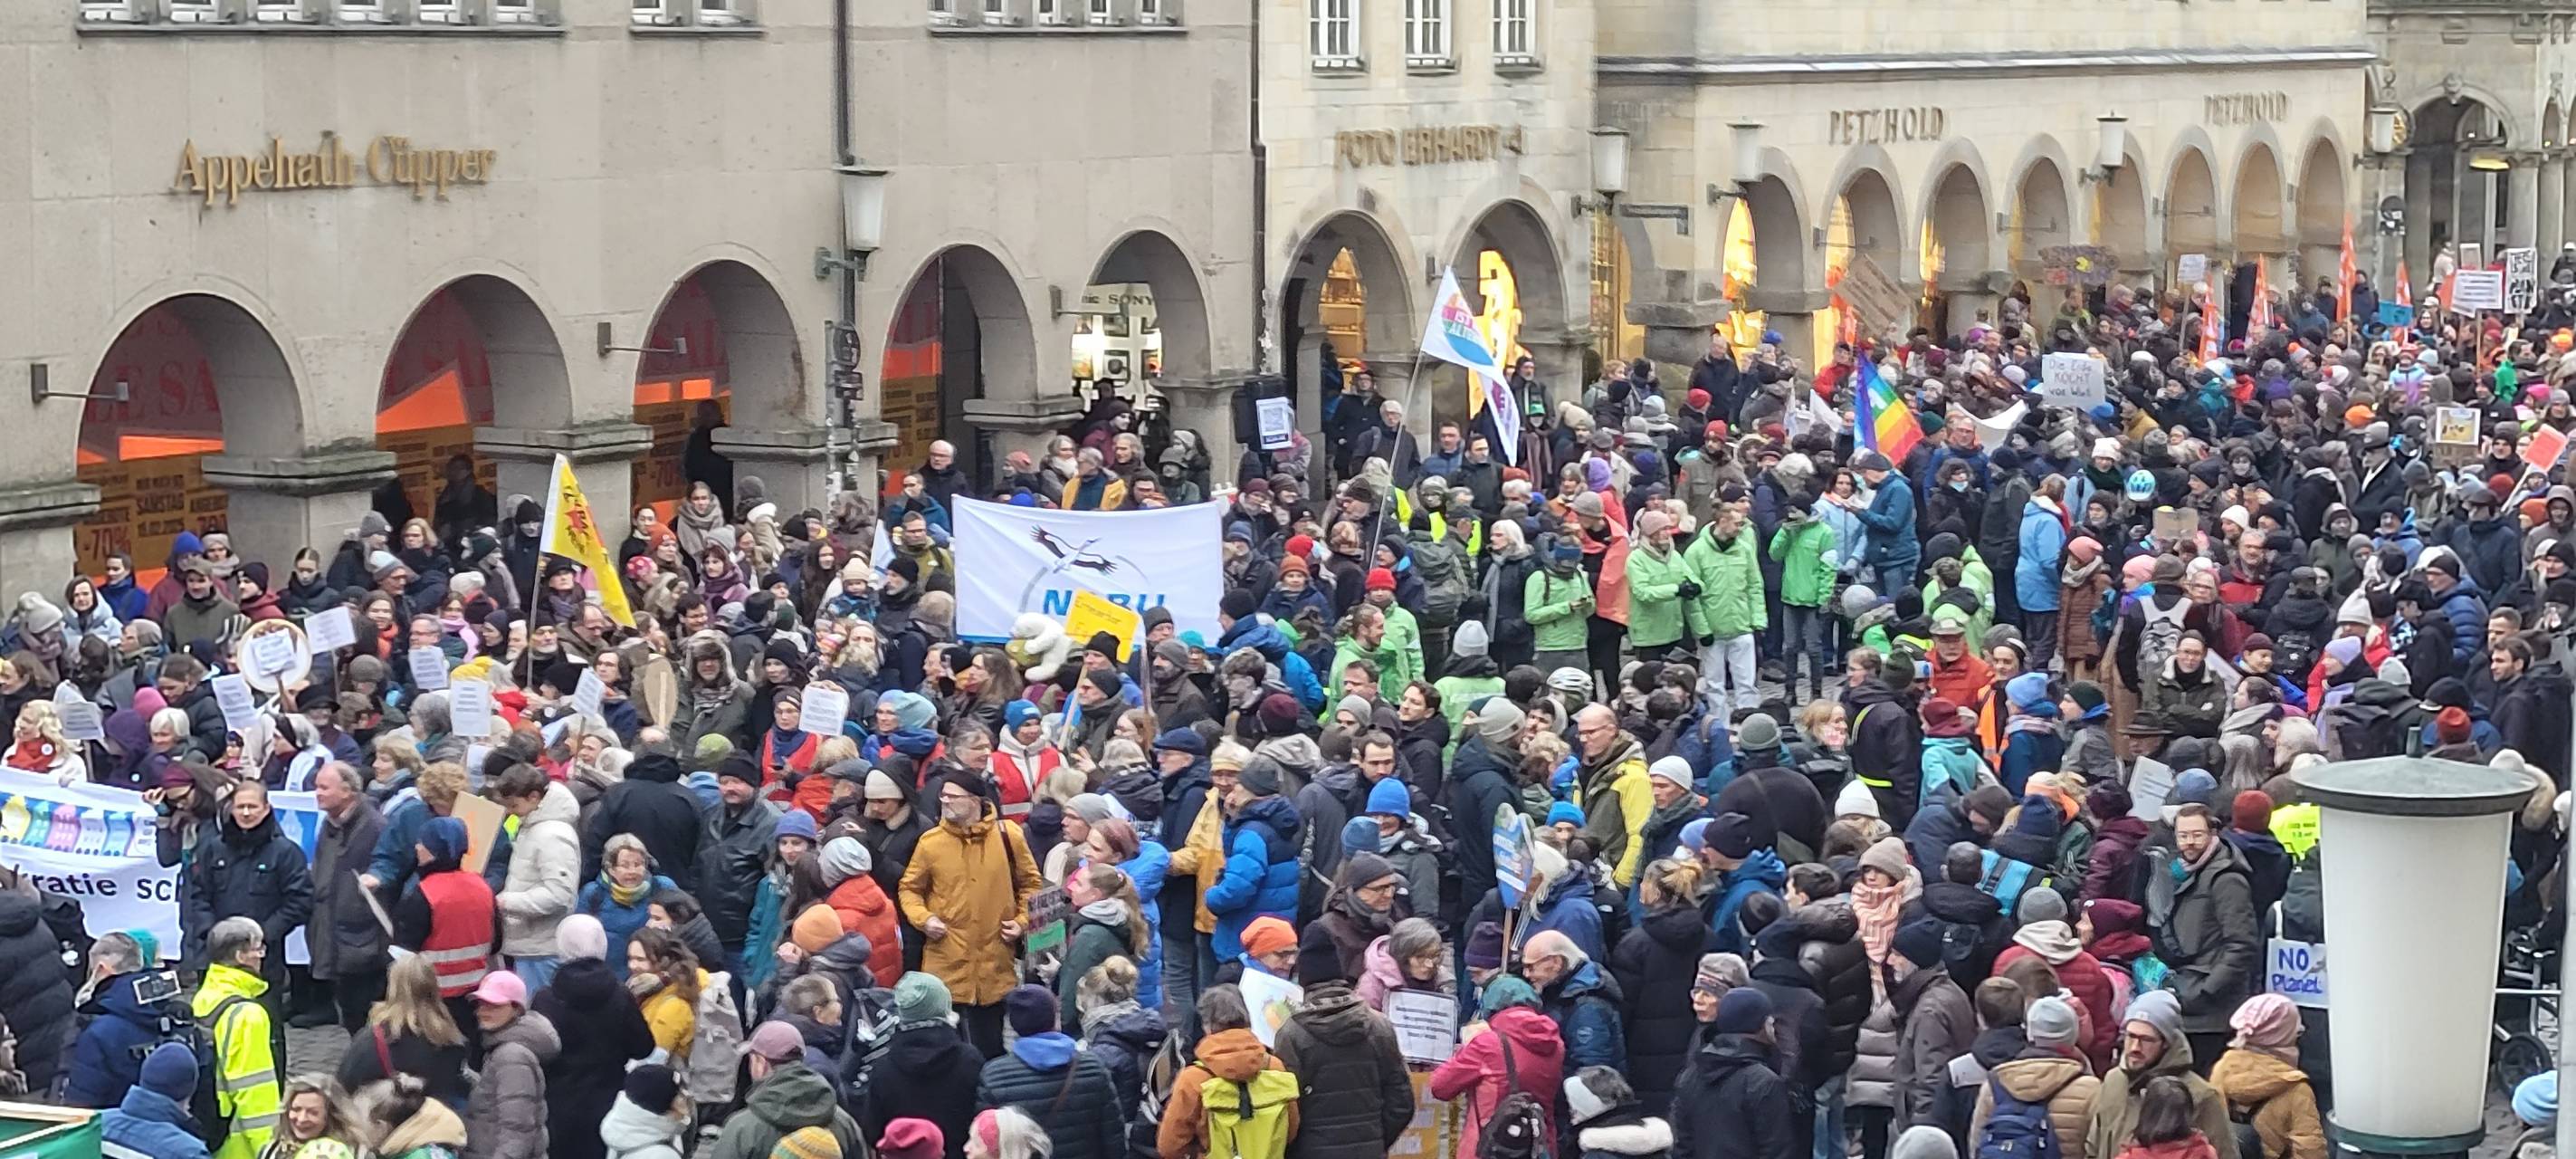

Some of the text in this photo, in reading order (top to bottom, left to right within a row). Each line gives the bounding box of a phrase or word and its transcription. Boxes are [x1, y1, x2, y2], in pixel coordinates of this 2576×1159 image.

[1828, 106, 1944, 146] PETZHOLD
[1333, 125, 1497, 171] FOTO ERHARDT
[1108, 292, 1153, 306] SONY
[2278, 947, 2309, 972] NO
